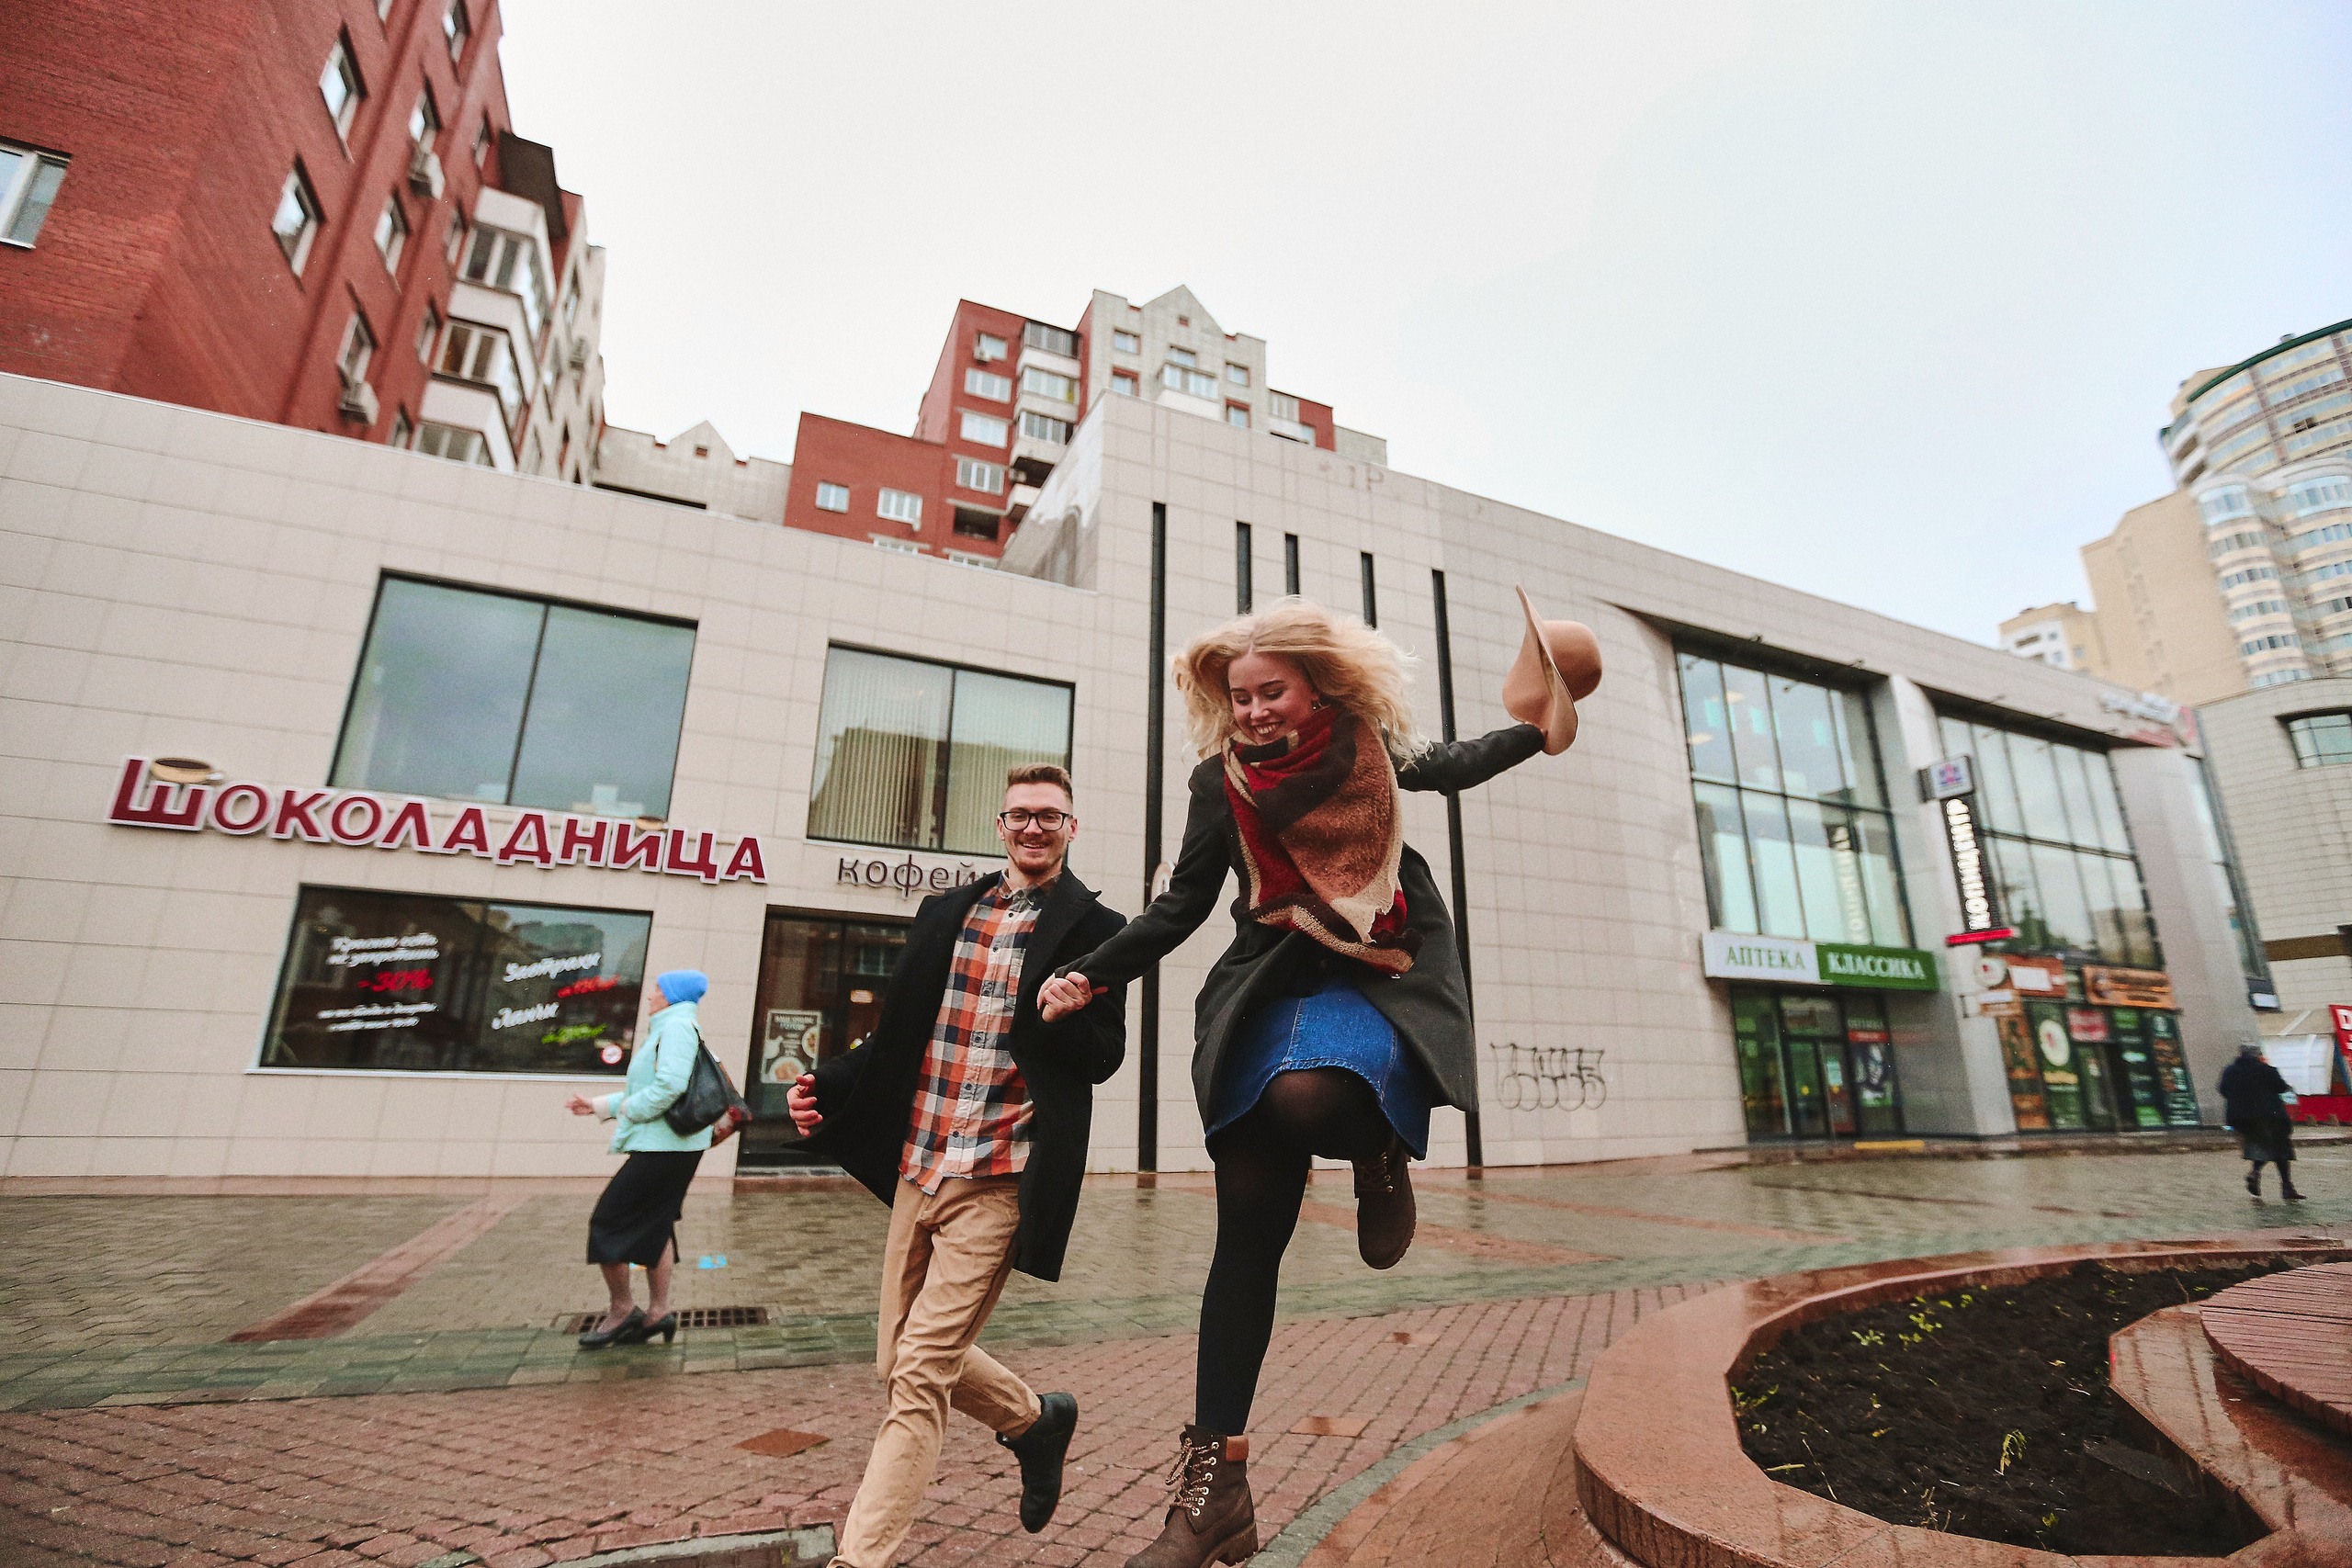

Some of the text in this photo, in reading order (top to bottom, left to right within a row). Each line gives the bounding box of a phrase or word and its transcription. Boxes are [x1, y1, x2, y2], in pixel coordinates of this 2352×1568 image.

[108, 756, 768, 884] ШОКОЛАДНИЦА
[837, 854, 989, 897] кофей
[1727, 946, 1806, 970] АПТЕКА
[1826, 952, 1926, 980] КЛАССИКА
